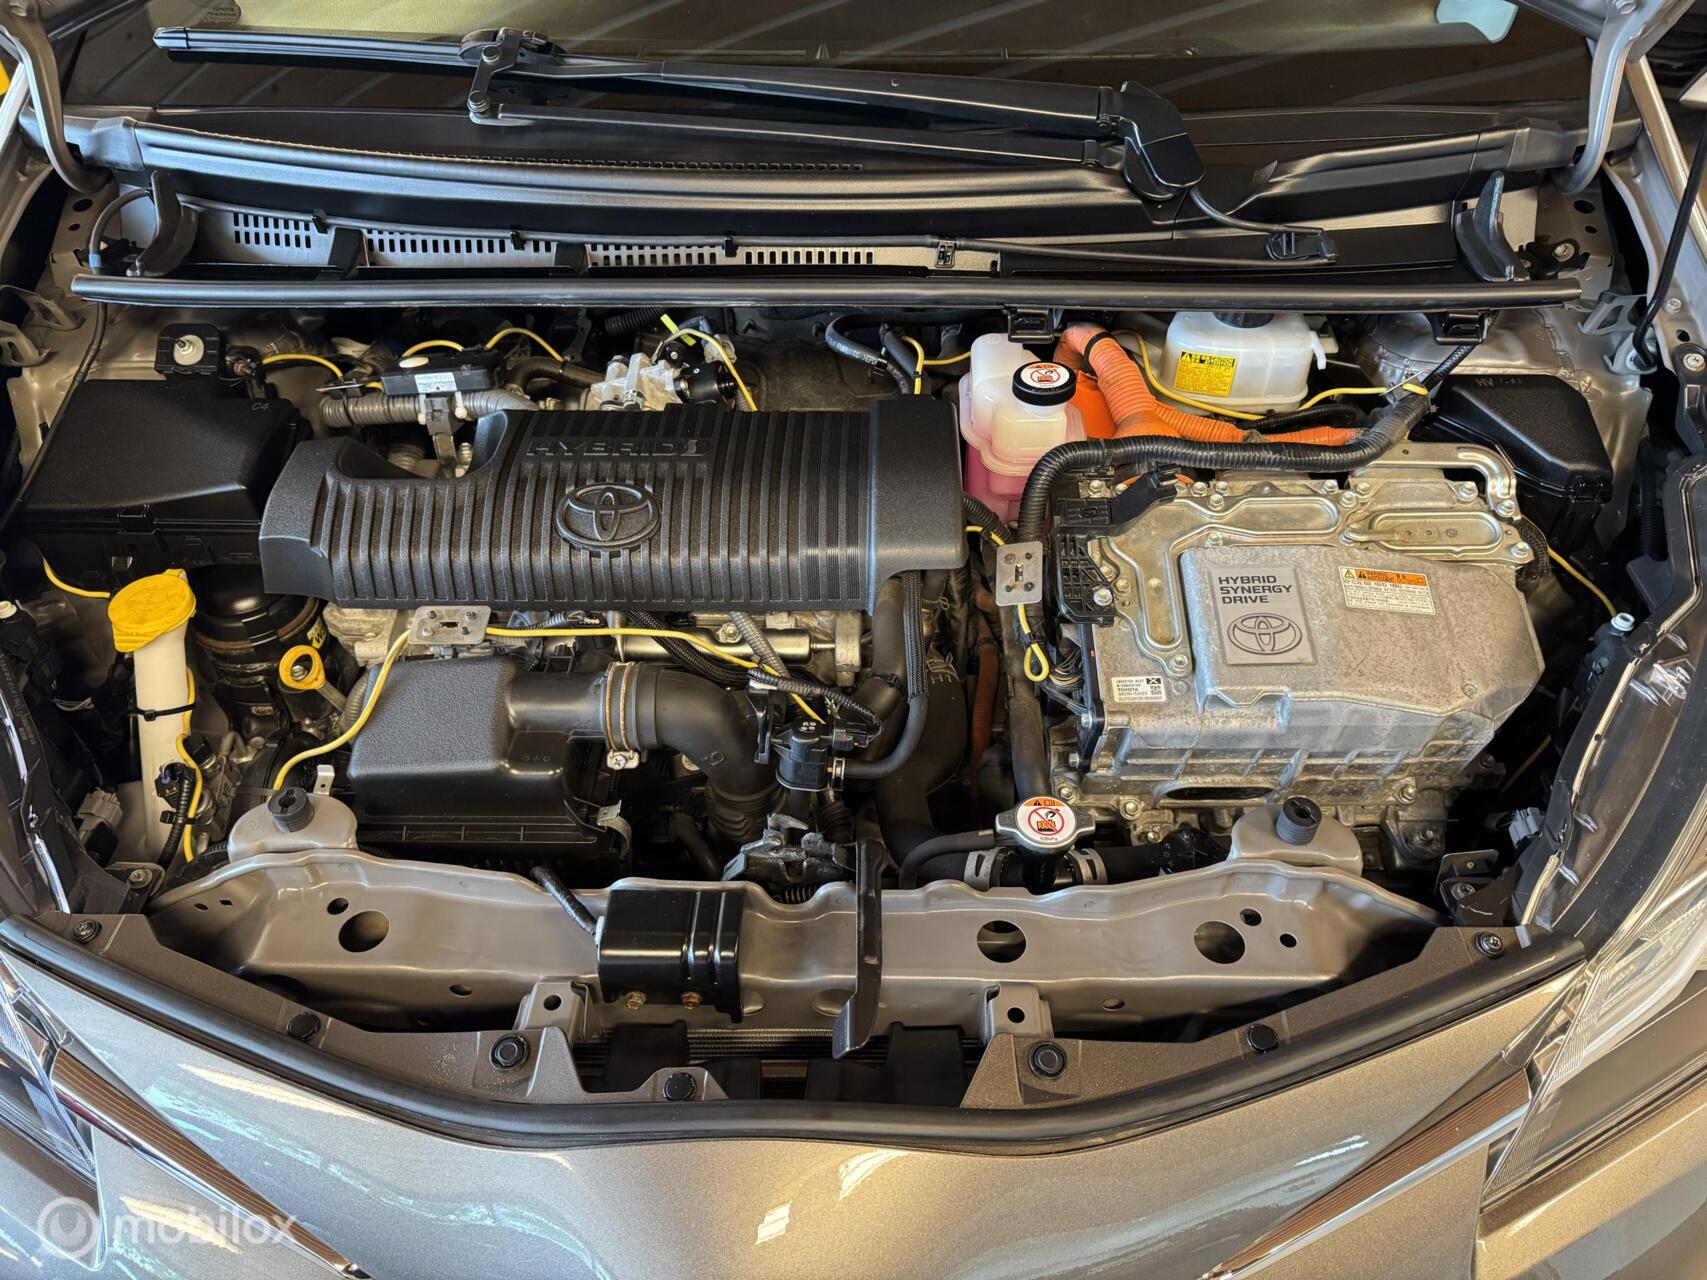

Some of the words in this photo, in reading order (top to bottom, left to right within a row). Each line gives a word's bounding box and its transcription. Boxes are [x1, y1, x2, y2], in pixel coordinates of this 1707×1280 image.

[525, 438, 678, 456] HYBRID
[1218, 575, 1277, 585] HYBRID
[1220, 584, 1292, 595] SYNERGY
[1222, 595, 1270, 604] DRIVE
